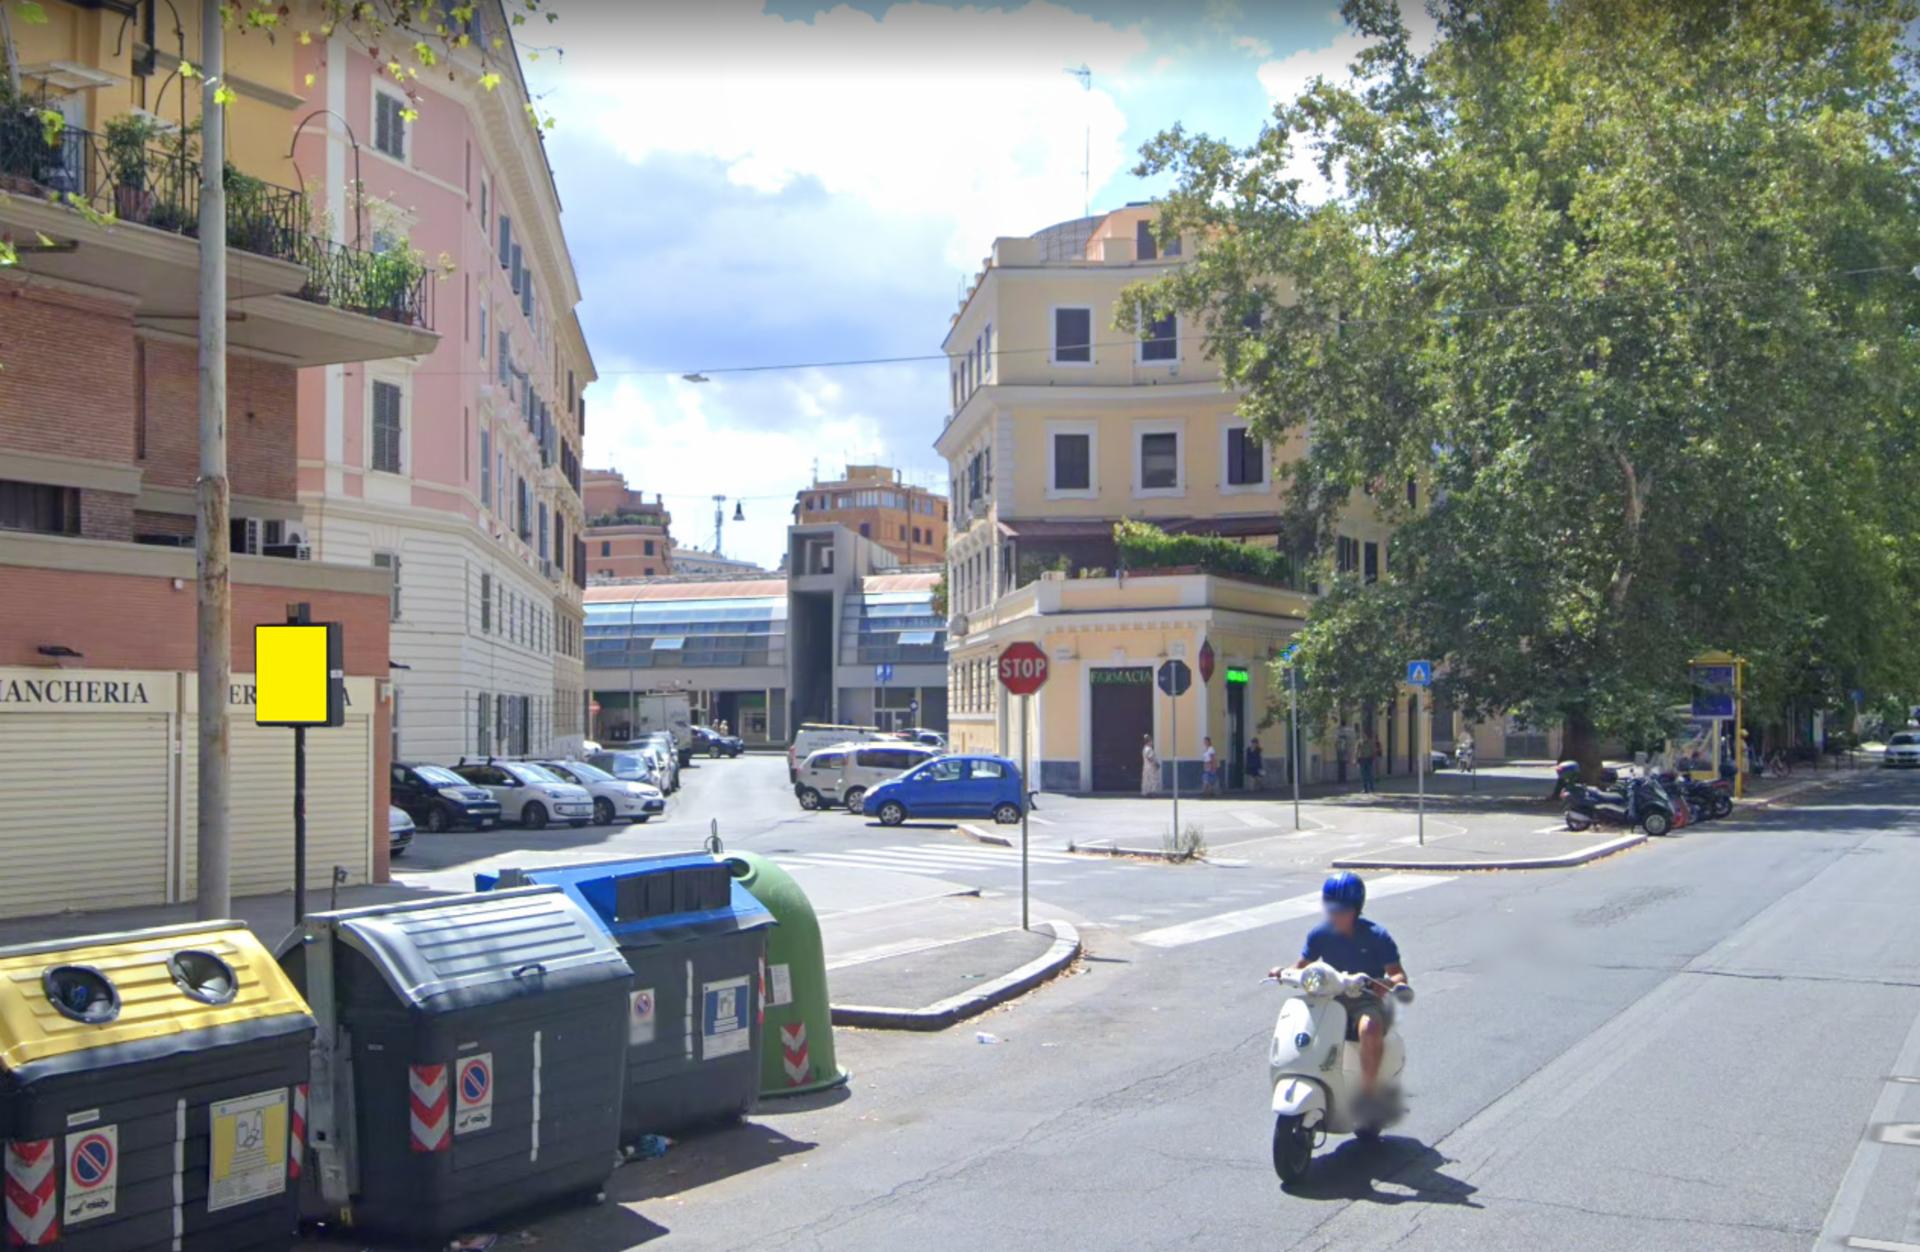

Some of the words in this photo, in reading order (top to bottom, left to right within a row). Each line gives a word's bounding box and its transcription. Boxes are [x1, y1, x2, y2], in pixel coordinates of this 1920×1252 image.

[1001, 658, 1046, 679] STOP
[1089, 670, 1153, 684] FARMACIA
[0, 679, 149, 703] ANCHERIA
